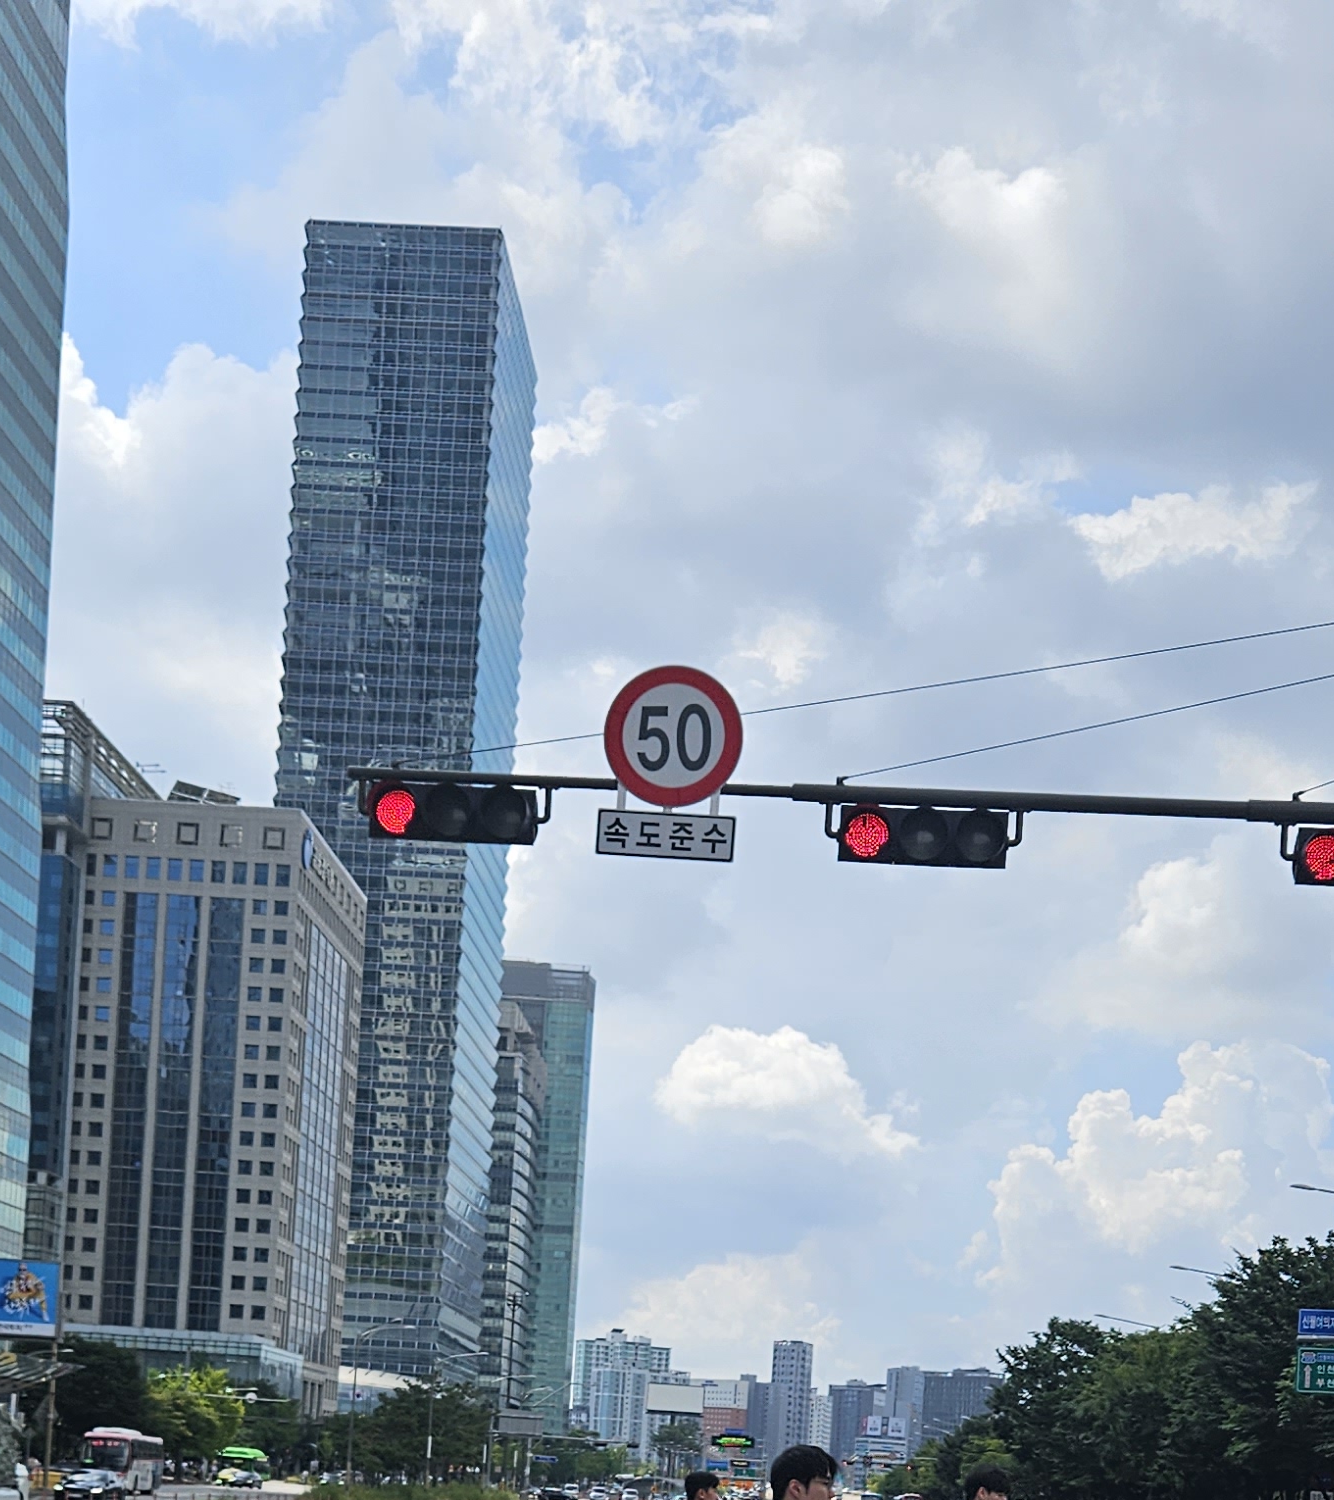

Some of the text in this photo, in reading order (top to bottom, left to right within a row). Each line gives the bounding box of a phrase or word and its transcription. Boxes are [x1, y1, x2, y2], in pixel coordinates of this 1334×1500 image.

[637, 703, 711, 771] 50
[604, 817, 727, 853] 속도준수
[1316, 1378, 1334, 1388] 부천
